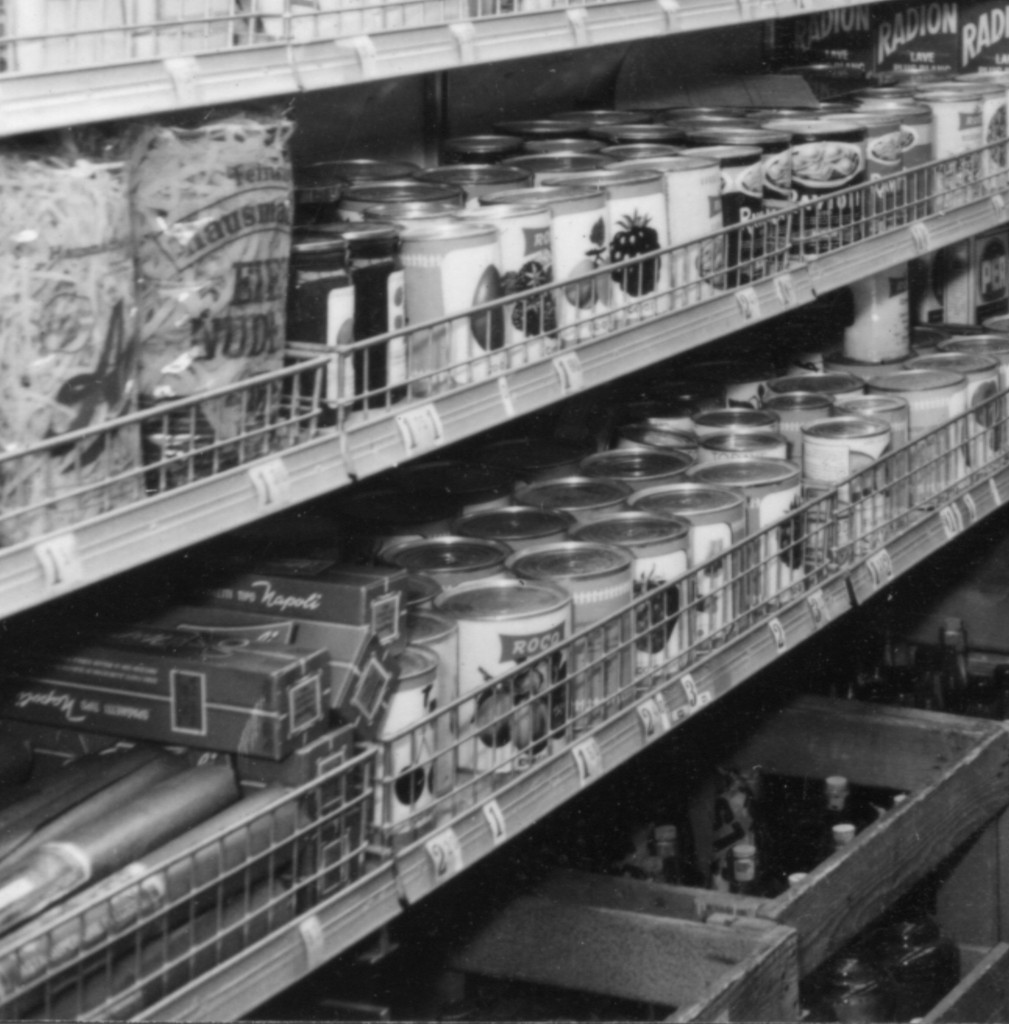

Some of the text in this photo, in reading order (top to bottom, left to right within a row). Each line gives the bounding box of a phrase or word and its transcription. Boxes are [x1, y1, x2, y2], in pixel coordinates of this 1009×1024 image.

[877, 2, 958, 65] RADION
[251, 579, 322, 611] Napoli
[512, 631, 561, 656] ROCO
[14, 690, 86, 722] Napoli
